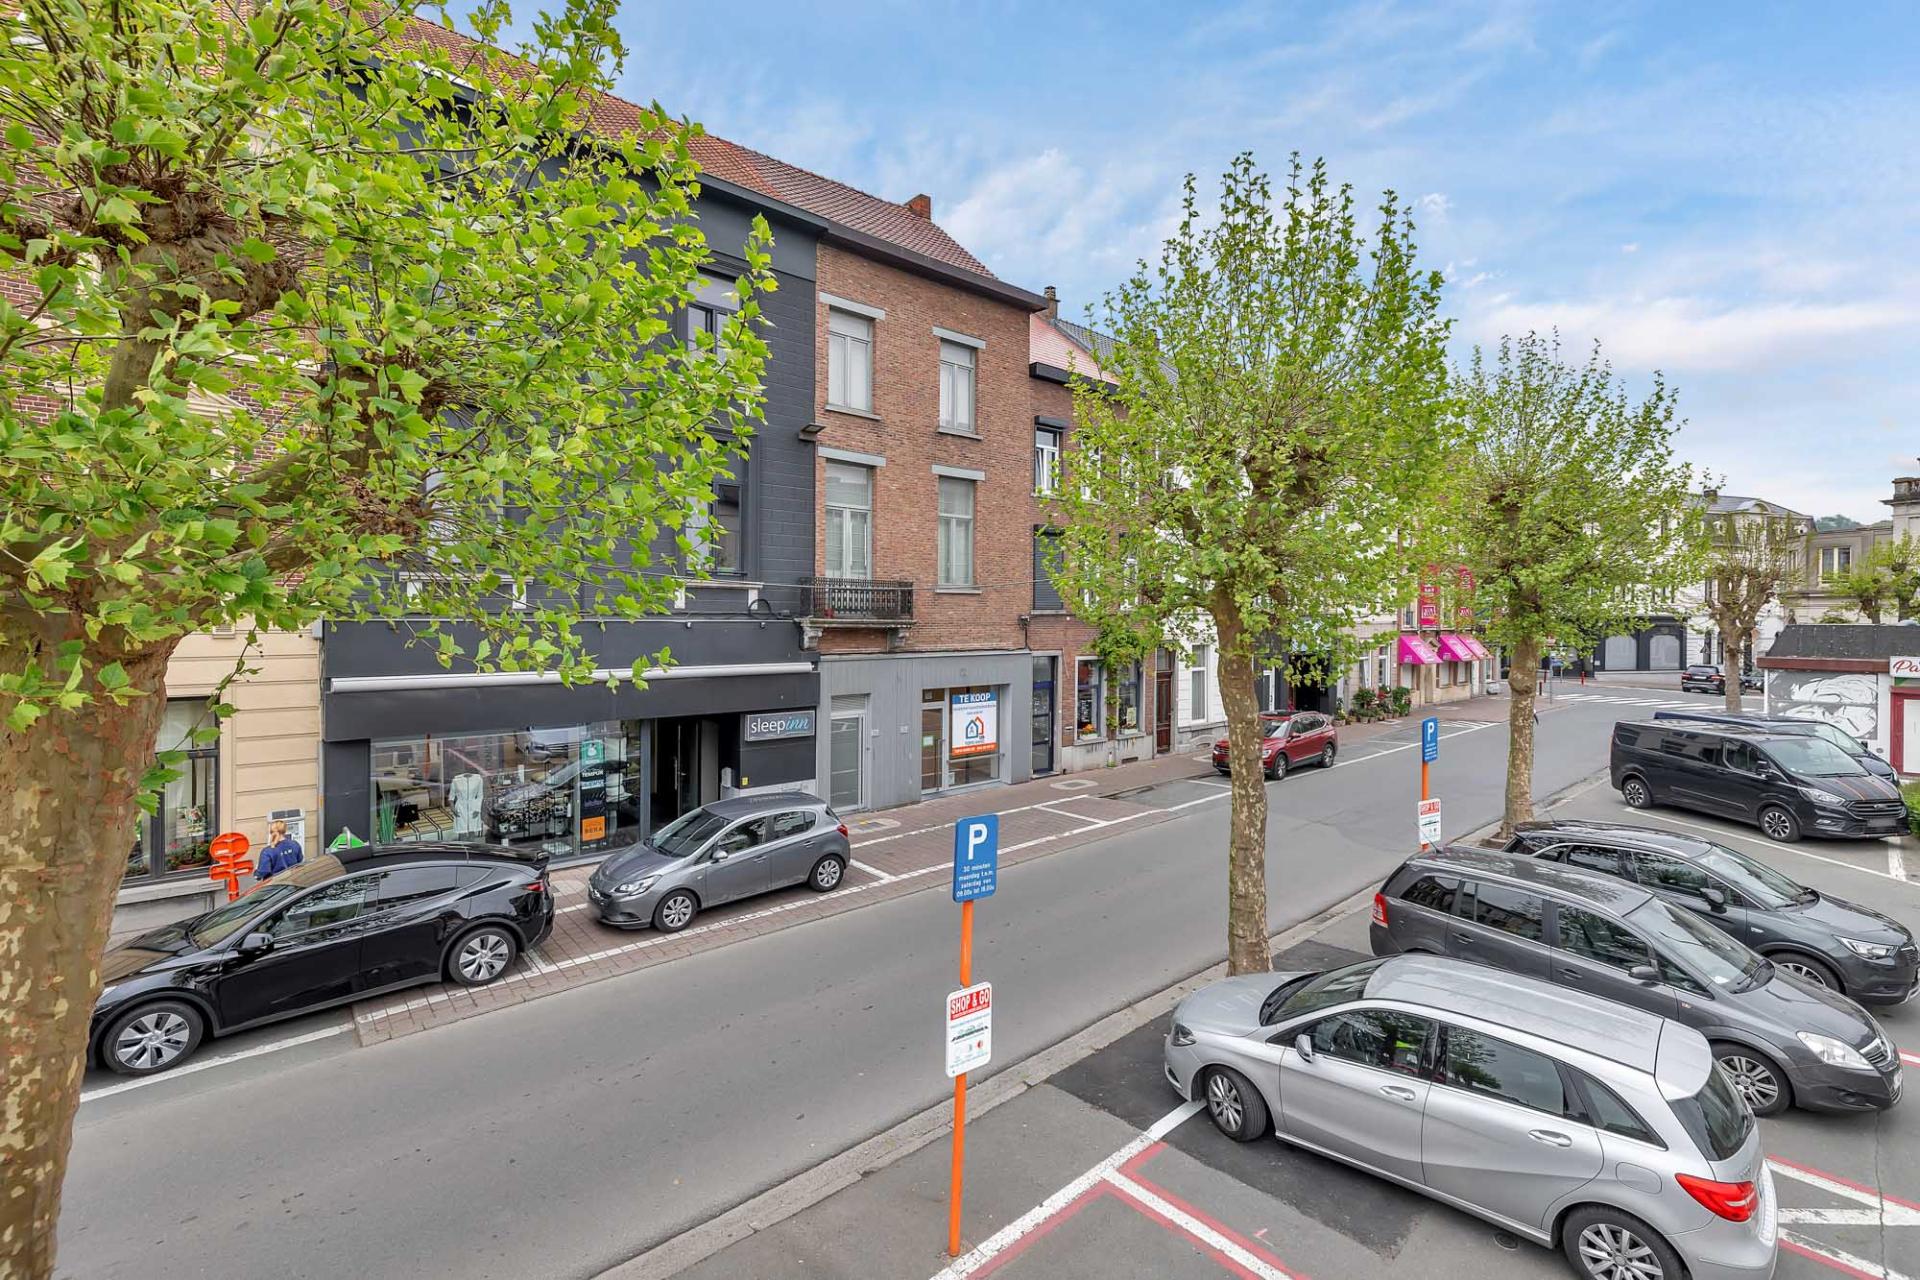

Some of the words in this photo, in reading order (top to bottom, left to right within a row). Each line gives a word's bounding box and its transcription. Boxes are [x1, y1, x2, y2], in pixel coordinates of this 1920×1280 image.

[1893, 660, 1920, 673] Pa
[960, 695, 969, 703] TE
[970, 693, 991, 703] KOOP
[1427, 722, 1434, 741] P
[968, 823, 988, 860] P
[951, 996, 970, 1014] SHOP
[972, 993, 977, 1007] &
[979, 989, 990, 1005] GO
